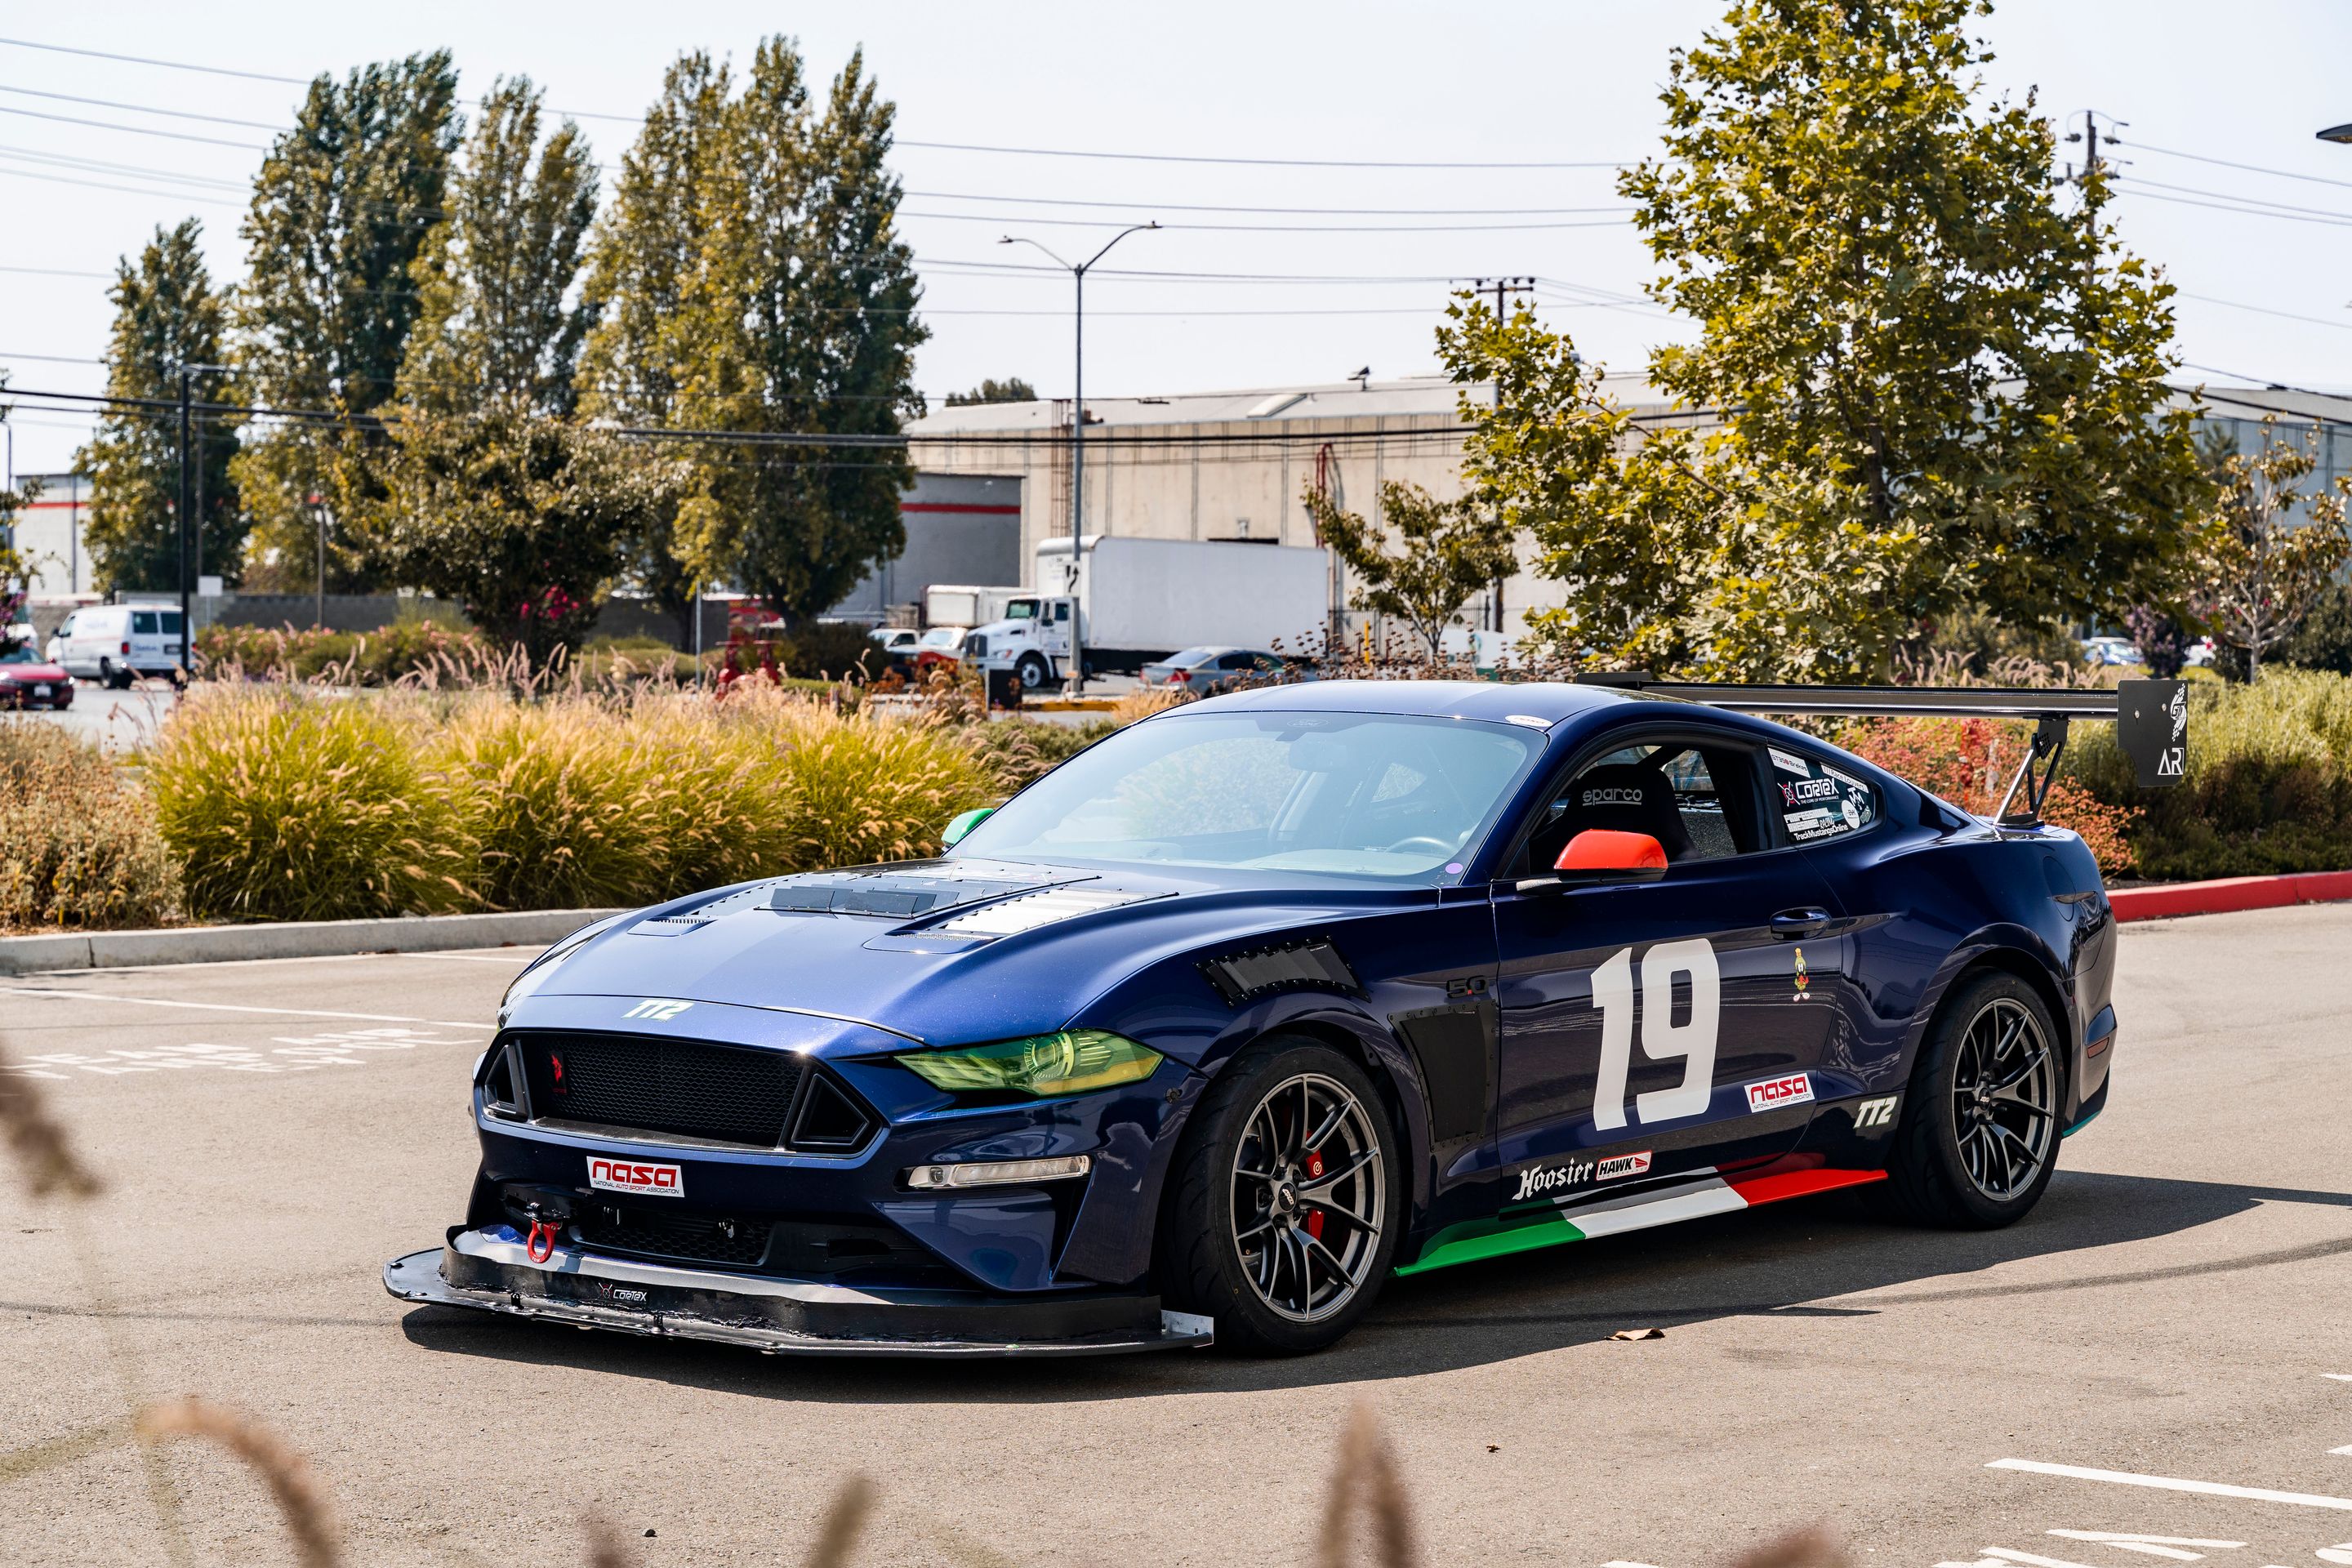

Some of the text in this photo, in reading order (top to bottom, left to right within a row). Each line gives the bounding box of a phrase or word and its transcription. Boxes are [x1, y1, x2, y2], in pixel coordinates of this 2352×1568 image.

[1788, 760, 1807, 771] Brakes
[1583, 789, 1642, 805] sparco
[1794, 823, 1848, 841] TrackMustangsOnline
[1446, 977, 1490, 998] 5.0
[621, 1000, 695, 1021] TT2
[1591, 938, 1720, 1131] 19
[1750, 1076, 1807, 1103] nasa
[1790, 1094, 1811, 1102] ASSOCIATION
[1853, 1096, 1897, 1129] TT2
[592, 1160, 677, 1187] nasa
[594, 1180, 614, 1188] NATIONAL
[1512, 1156, 1634, 1200] Hoosier HAWK
